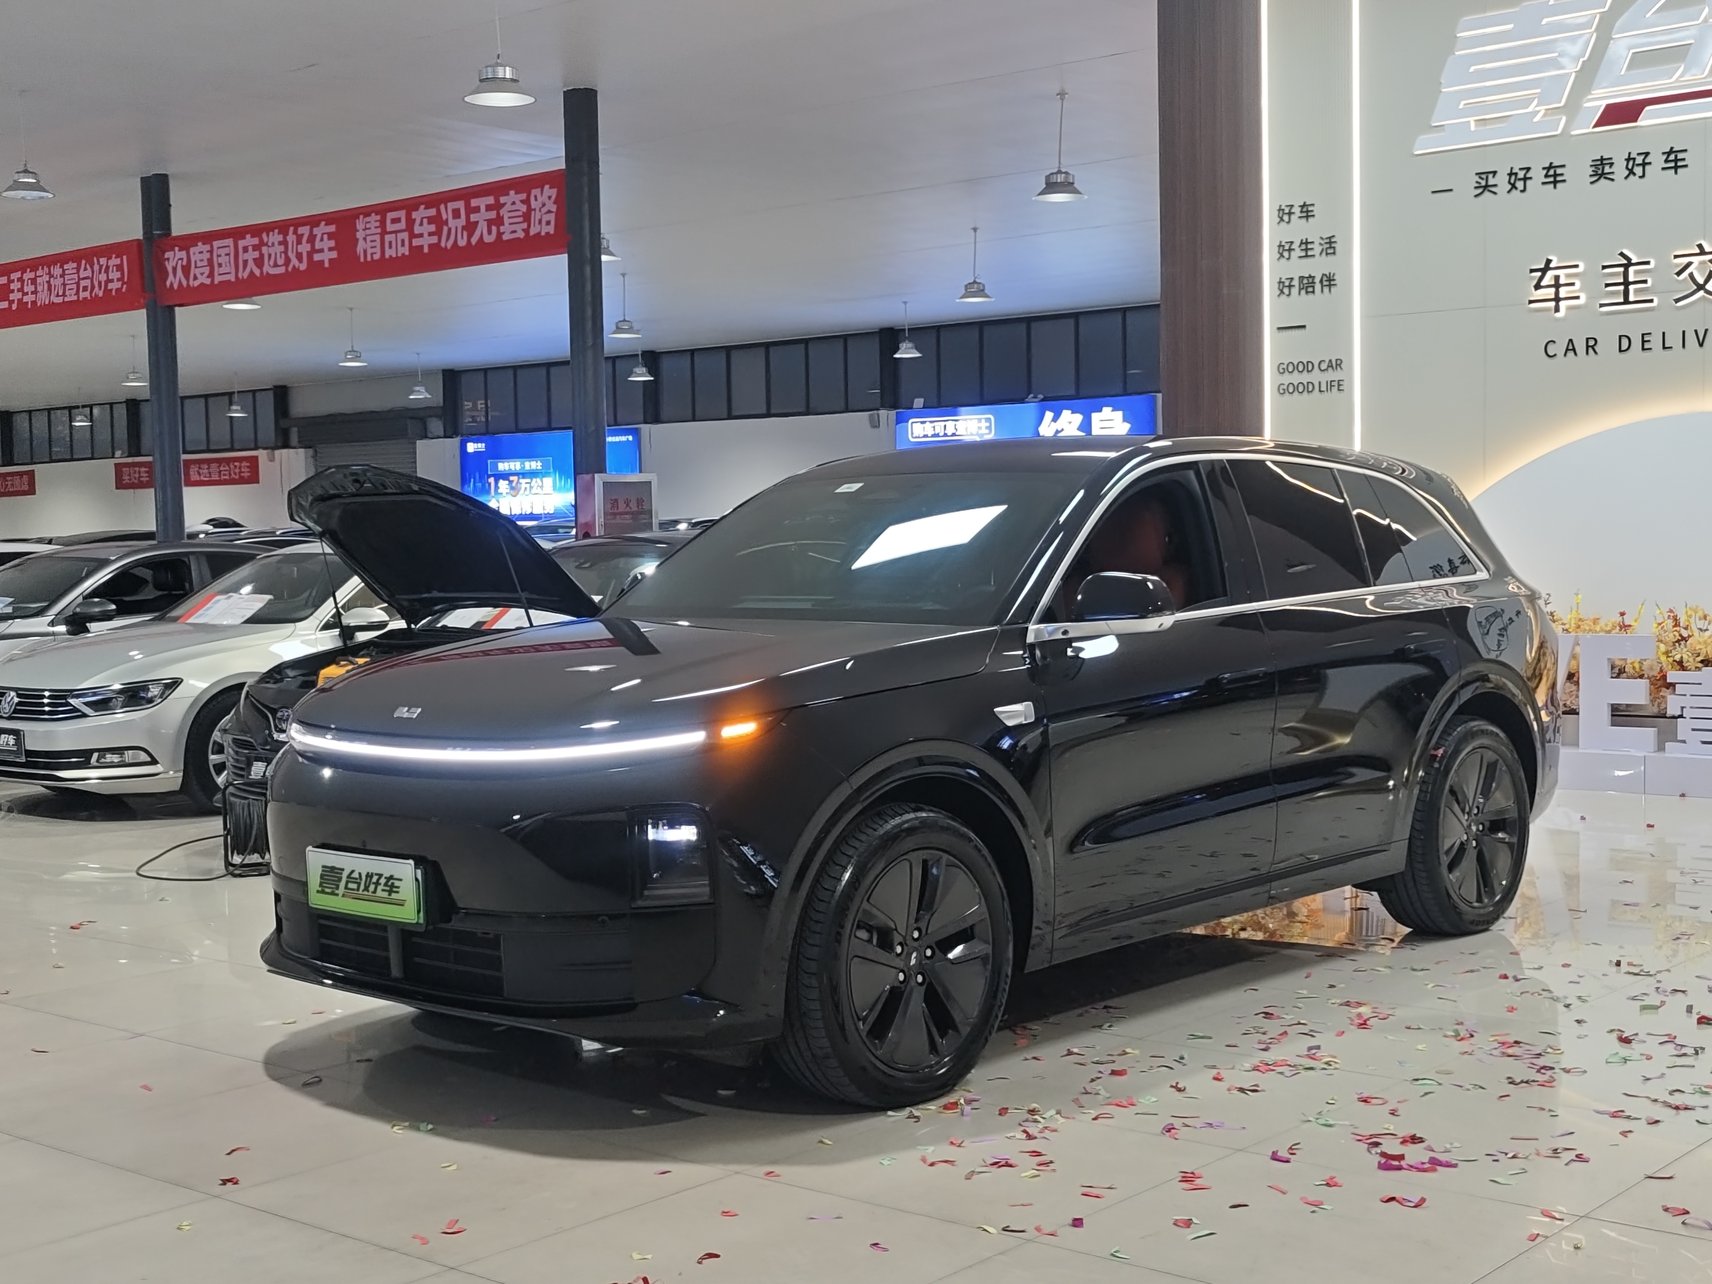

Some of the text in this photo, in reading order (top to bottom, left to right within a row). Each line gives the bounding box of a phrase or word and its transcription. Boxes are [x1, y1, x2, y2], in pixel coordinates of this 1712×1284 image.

[1473, 146, 1689, 198] 买好车 卖好车
[1276, 201, 1316, 225] 好车
[163, 183, 558, 290] 欢度国庆选好车 精品车况无套路
[1276, 235, 1337, 261] 好生活
[1276, 272, 1337, 298] 好陪伴
[1543, 328, 1709, 359] CAR DELIV
[1277, 358, 1344, 375] GOOD CAR
[1277, 379, 1345, 395] GOOD LIFE
[316, 864, 403, 897] 壹台好车
